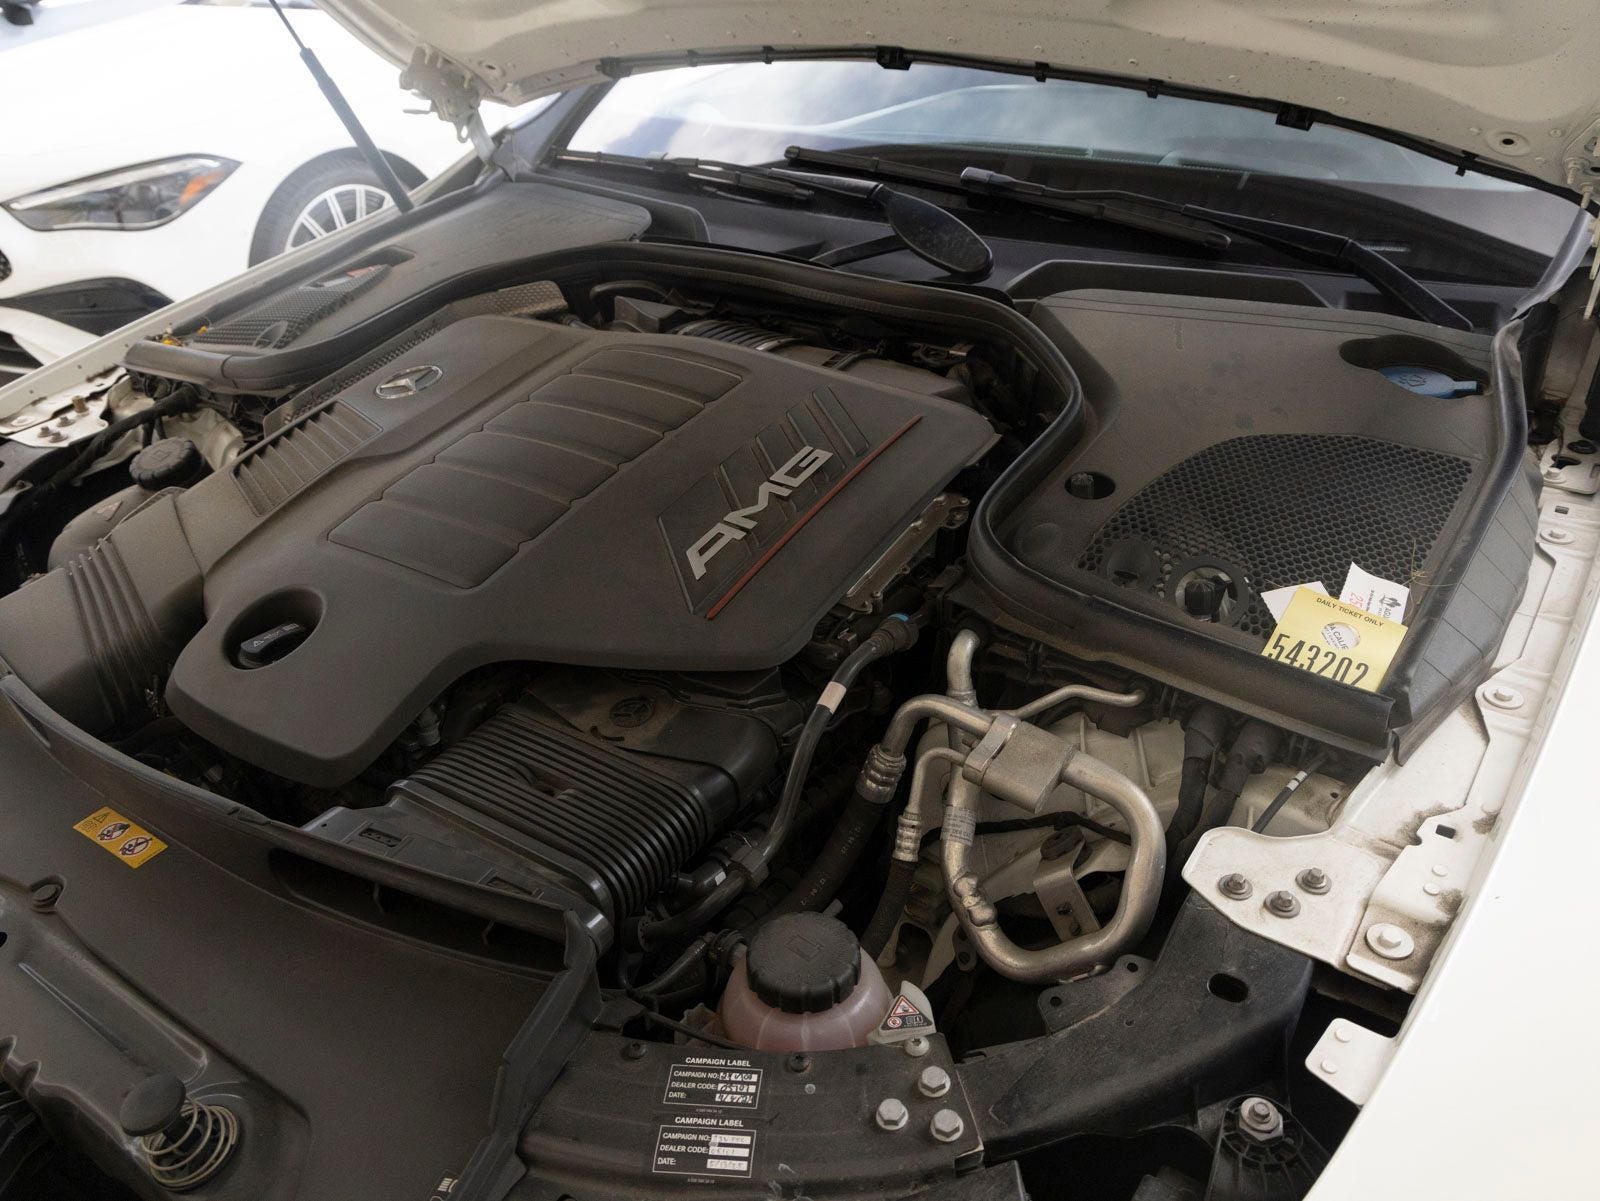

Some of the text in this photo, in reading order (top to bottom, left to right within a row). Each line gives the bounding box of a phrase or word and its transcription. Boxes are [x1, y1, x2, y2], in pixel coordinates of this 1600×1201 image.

[686, 445, 833, 580] AMG
[1316, 597, 1385, 628] DAILY TICKET ONLY
[1268, 633, 1369, 685] 543202
[685, 1057, 751, 1067] CAMPAIGN LABEL
[673, 1070, 707, 1078] CAMPAIGN
[675, 1116, 744, 1128] CAMPAIGN LABEL
[662, 1132, 697, 1141] CAMPAIGN
[698, 1134, 711, 1142] NO:
[660, 1144, 709, 1154] DEALER CODE:
[657, 1157, 677, 1166] DATE:
